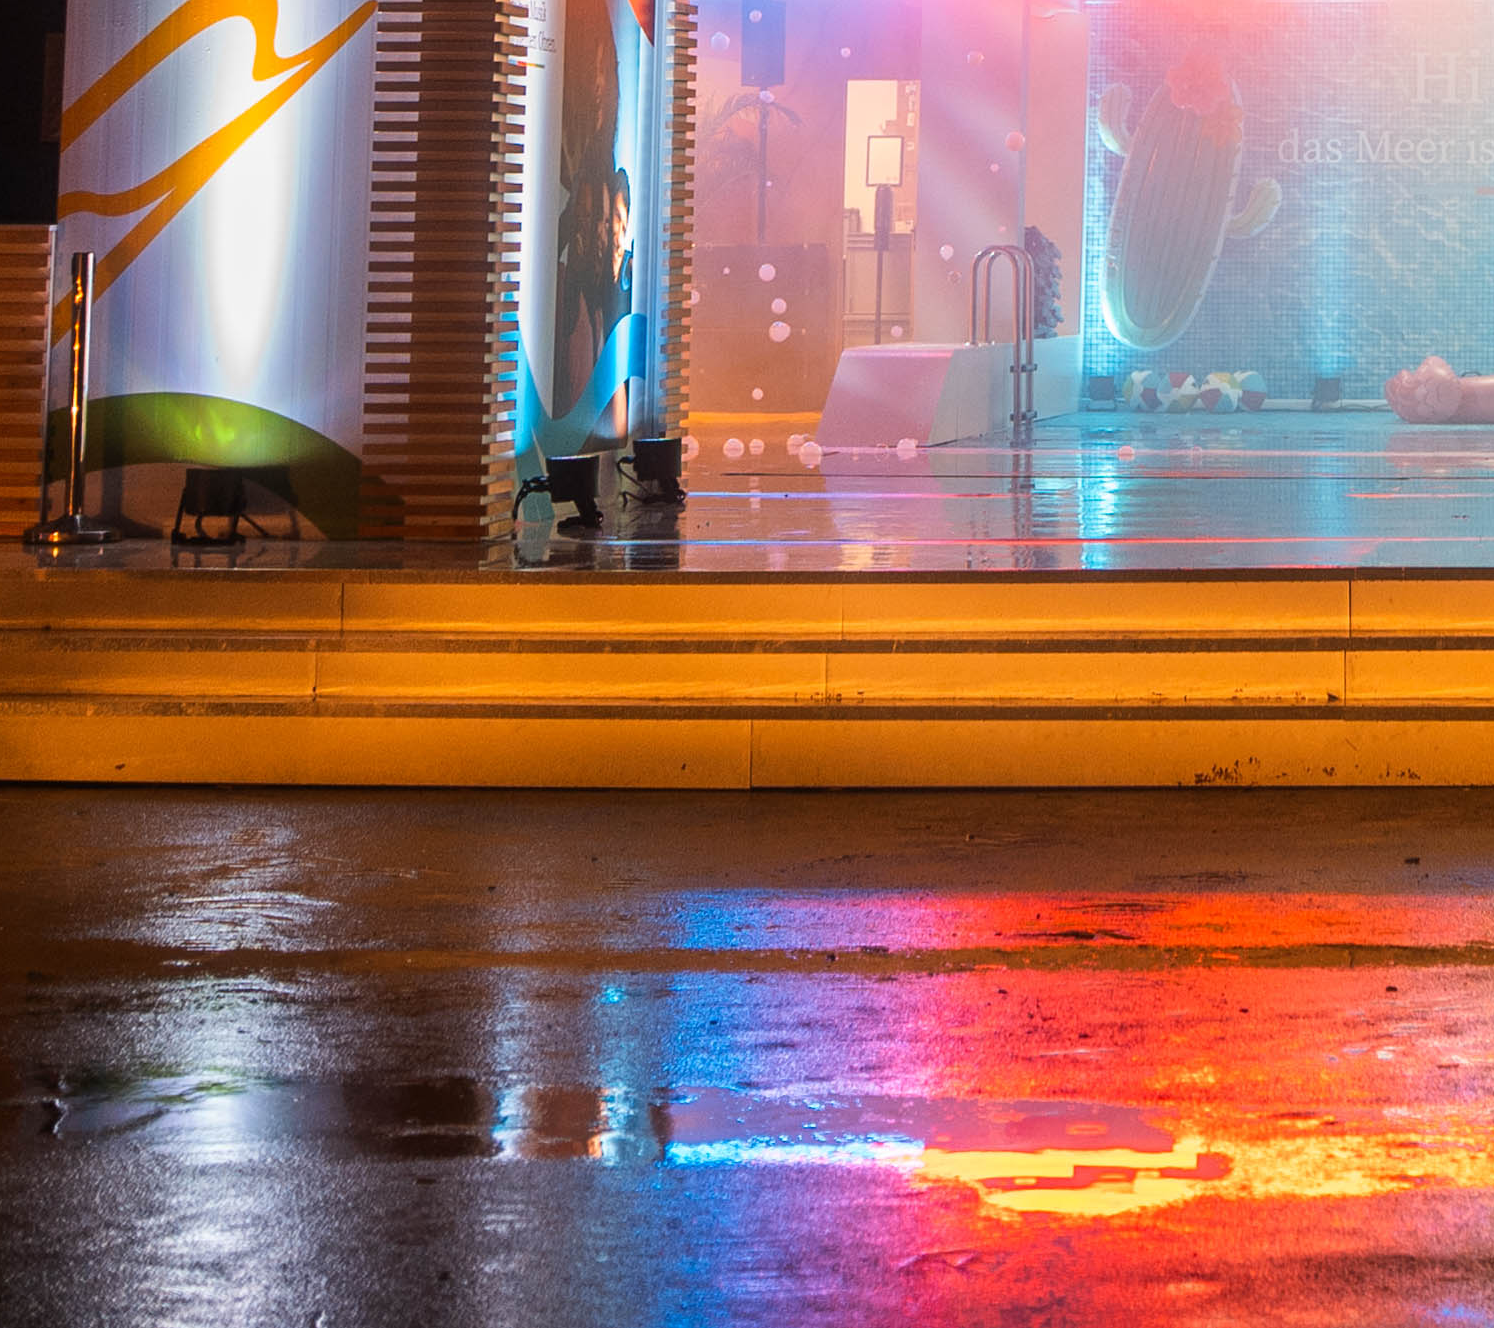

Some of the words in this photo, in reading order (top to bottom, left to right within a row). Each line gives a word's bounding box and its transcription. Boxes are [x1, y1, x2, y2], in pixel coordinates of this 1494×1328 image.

[1411, 51, 1487, 105] Hi
[1278, 129, 1344, 164] das
[1354, 131, 1458, 164] Meer
